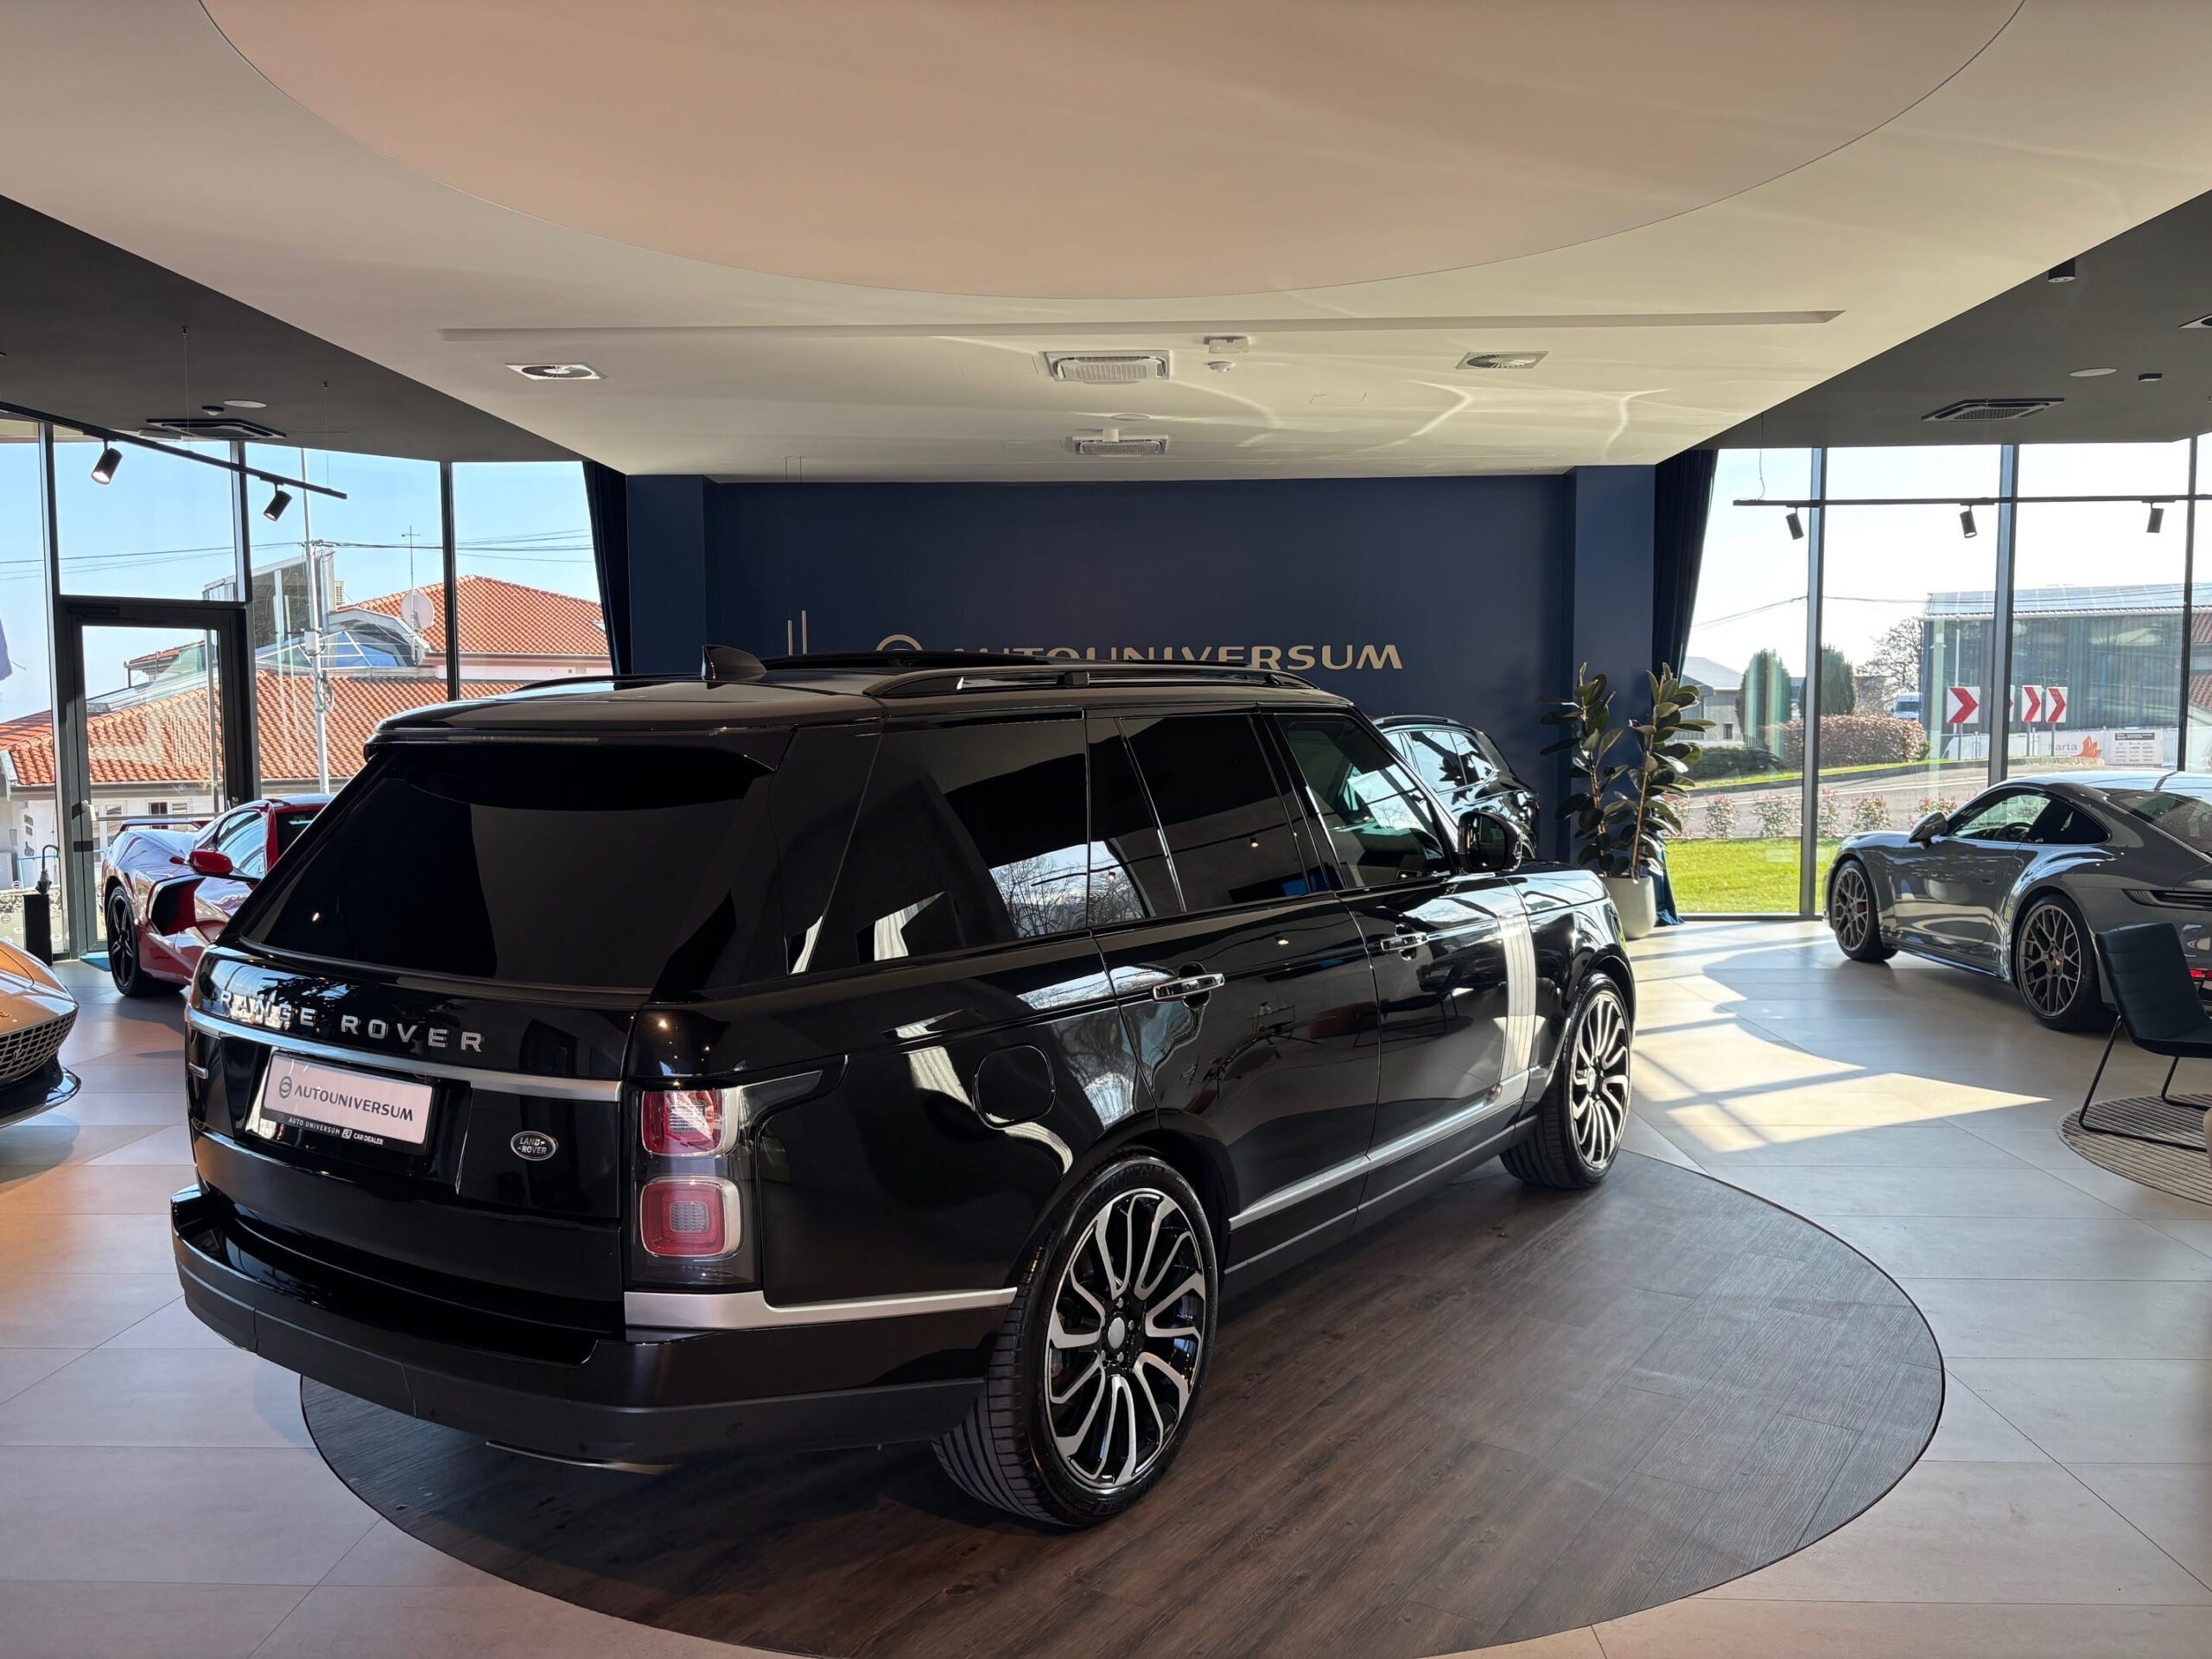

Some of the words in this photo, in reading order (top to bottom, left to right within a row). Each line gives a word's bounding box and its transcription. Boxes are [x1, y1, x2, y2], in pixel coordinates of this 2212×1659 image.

[953, 645, 1403, 670] UNIVERSUM
[220, 989, 316, 1027] RANGE
[340, 1014, 483, 1052] ROVER
[294, 1084, 414, 1122] AUTOUNIVERSUM
[288, 1116, 304, 1127] AUTO
[305, 1122, 340, 1135] UNIVERSUM
[353, 1133, 364, 1141] CAR
[364, 1135, 384, 1146] DEALER
